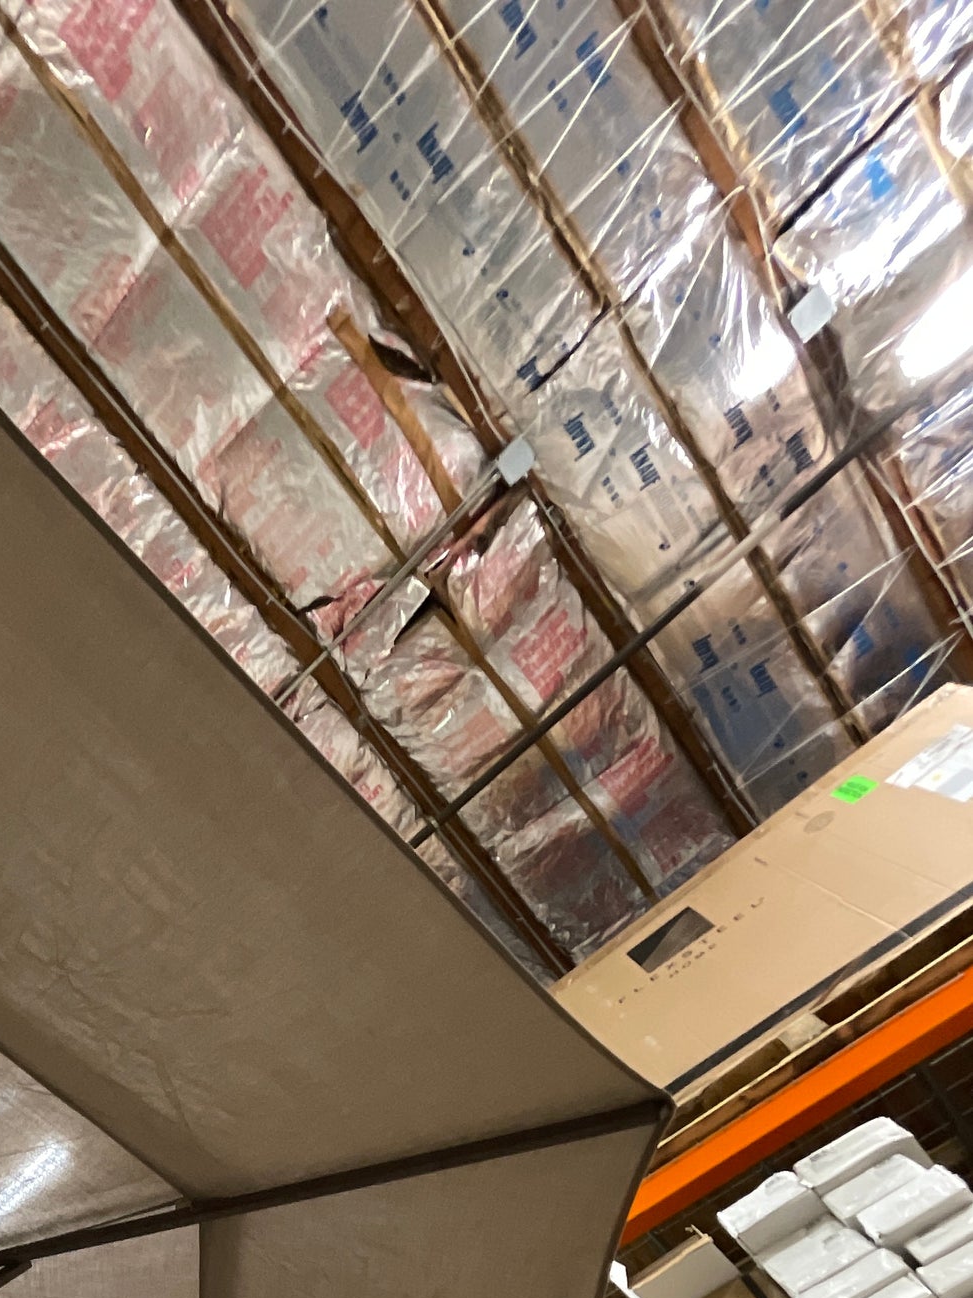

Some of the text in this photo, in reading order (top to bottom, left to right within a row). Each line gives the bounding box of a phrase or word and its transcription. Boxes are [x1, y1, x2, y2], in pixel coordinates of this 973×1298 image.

[564, 412, 595, 461] KNAUF
[724, 400, 753, 451] KNAUF
[630, 443, 661, 491] KNAUF
[786, 427, 814, 474] KNAUF
[692, 633, 719, 674] KNAUF
[750, 658, 778, 697] KNAUF
